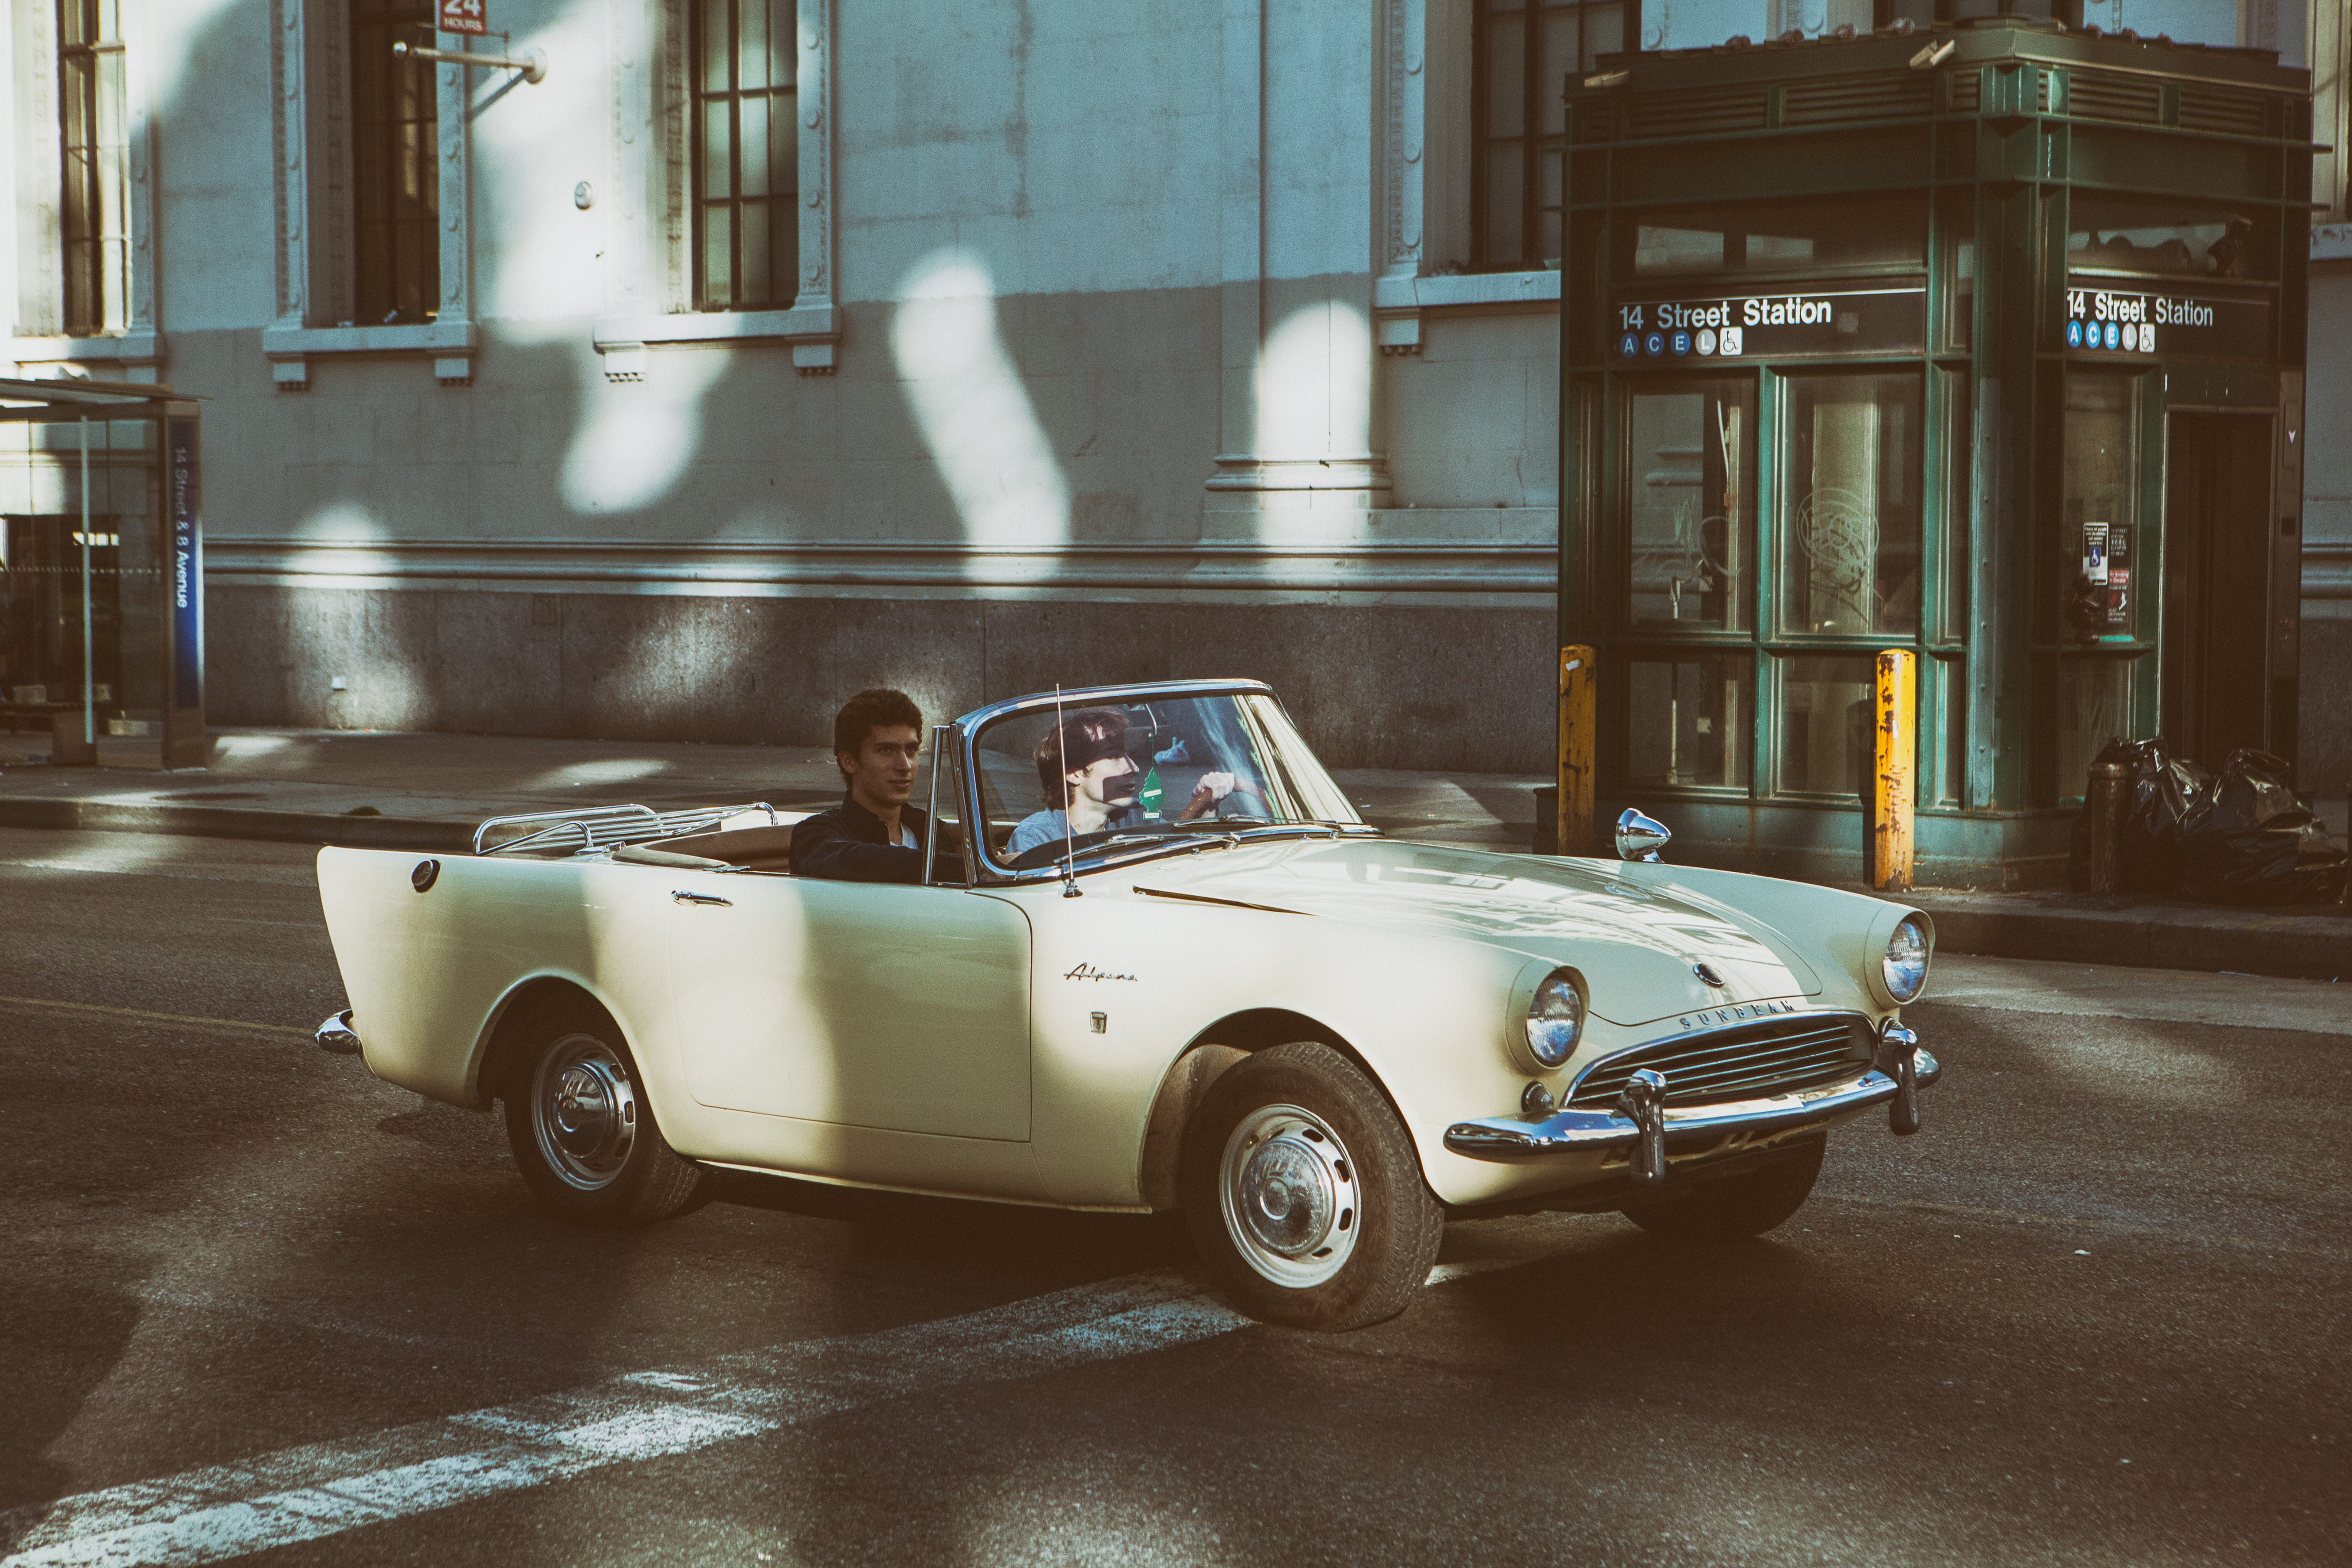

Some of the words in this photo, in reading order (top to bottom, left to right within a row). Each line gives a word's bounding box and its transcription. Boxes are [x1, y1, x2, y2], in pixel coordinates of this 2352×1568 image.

[445, 0, 482, 16] 24
[444, 17, 483, 32] HOURS
[1619, 305, 1644, 329] 14
[1658, 301, 1730, 328] Street
[1743, 297, 1832, 326] Station
[2067, 291, 2086, 319] 14
[2095, 292, 2146, 322] Street
[2155, 297, 2213, 326] Station
[176, 448, 187, 462] 14
[175, 469, 188, 515] Street
[176, 521, 189, 531] &
[177, 536, 189, 546] 8
[176, 550, 189, 608] Avenue
[1064, 962, 1137, 982] Alpine
[1679, 1000, 1795, 1029] SUNBEAM
